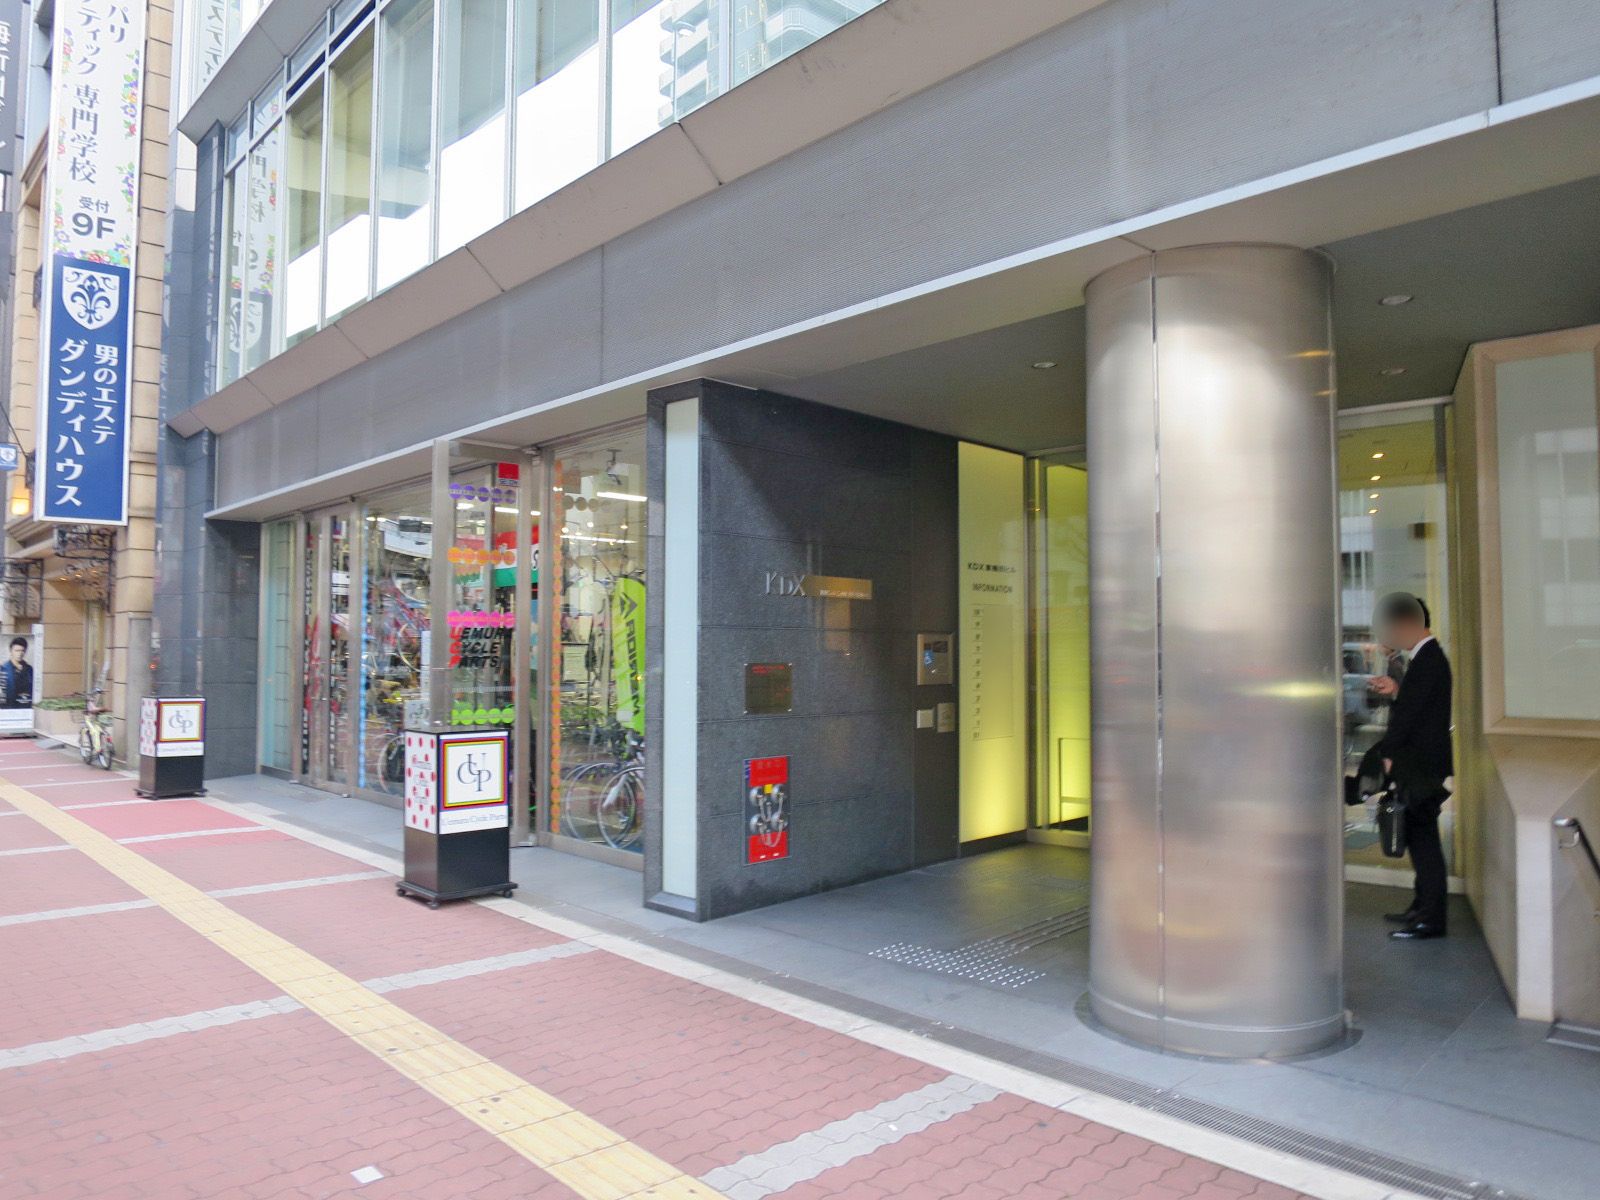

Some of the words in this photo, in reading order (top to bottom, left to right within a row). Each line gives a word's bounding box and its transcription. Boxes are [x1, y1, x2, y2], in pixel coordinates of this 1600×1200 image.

[107, 5, 129, 43] パリ
[69, 84, 100, 184] 専門学校
[79, 196, 110, 214] 受付
[72, 212, 116, 239] 9F
[91, 343, 119, 445] 男のエステ
[55, 337, 89, 507] ダンディハウス
[448, 656, 500, 668] PARTS
[449, 641, 501, 654] CYCLE
